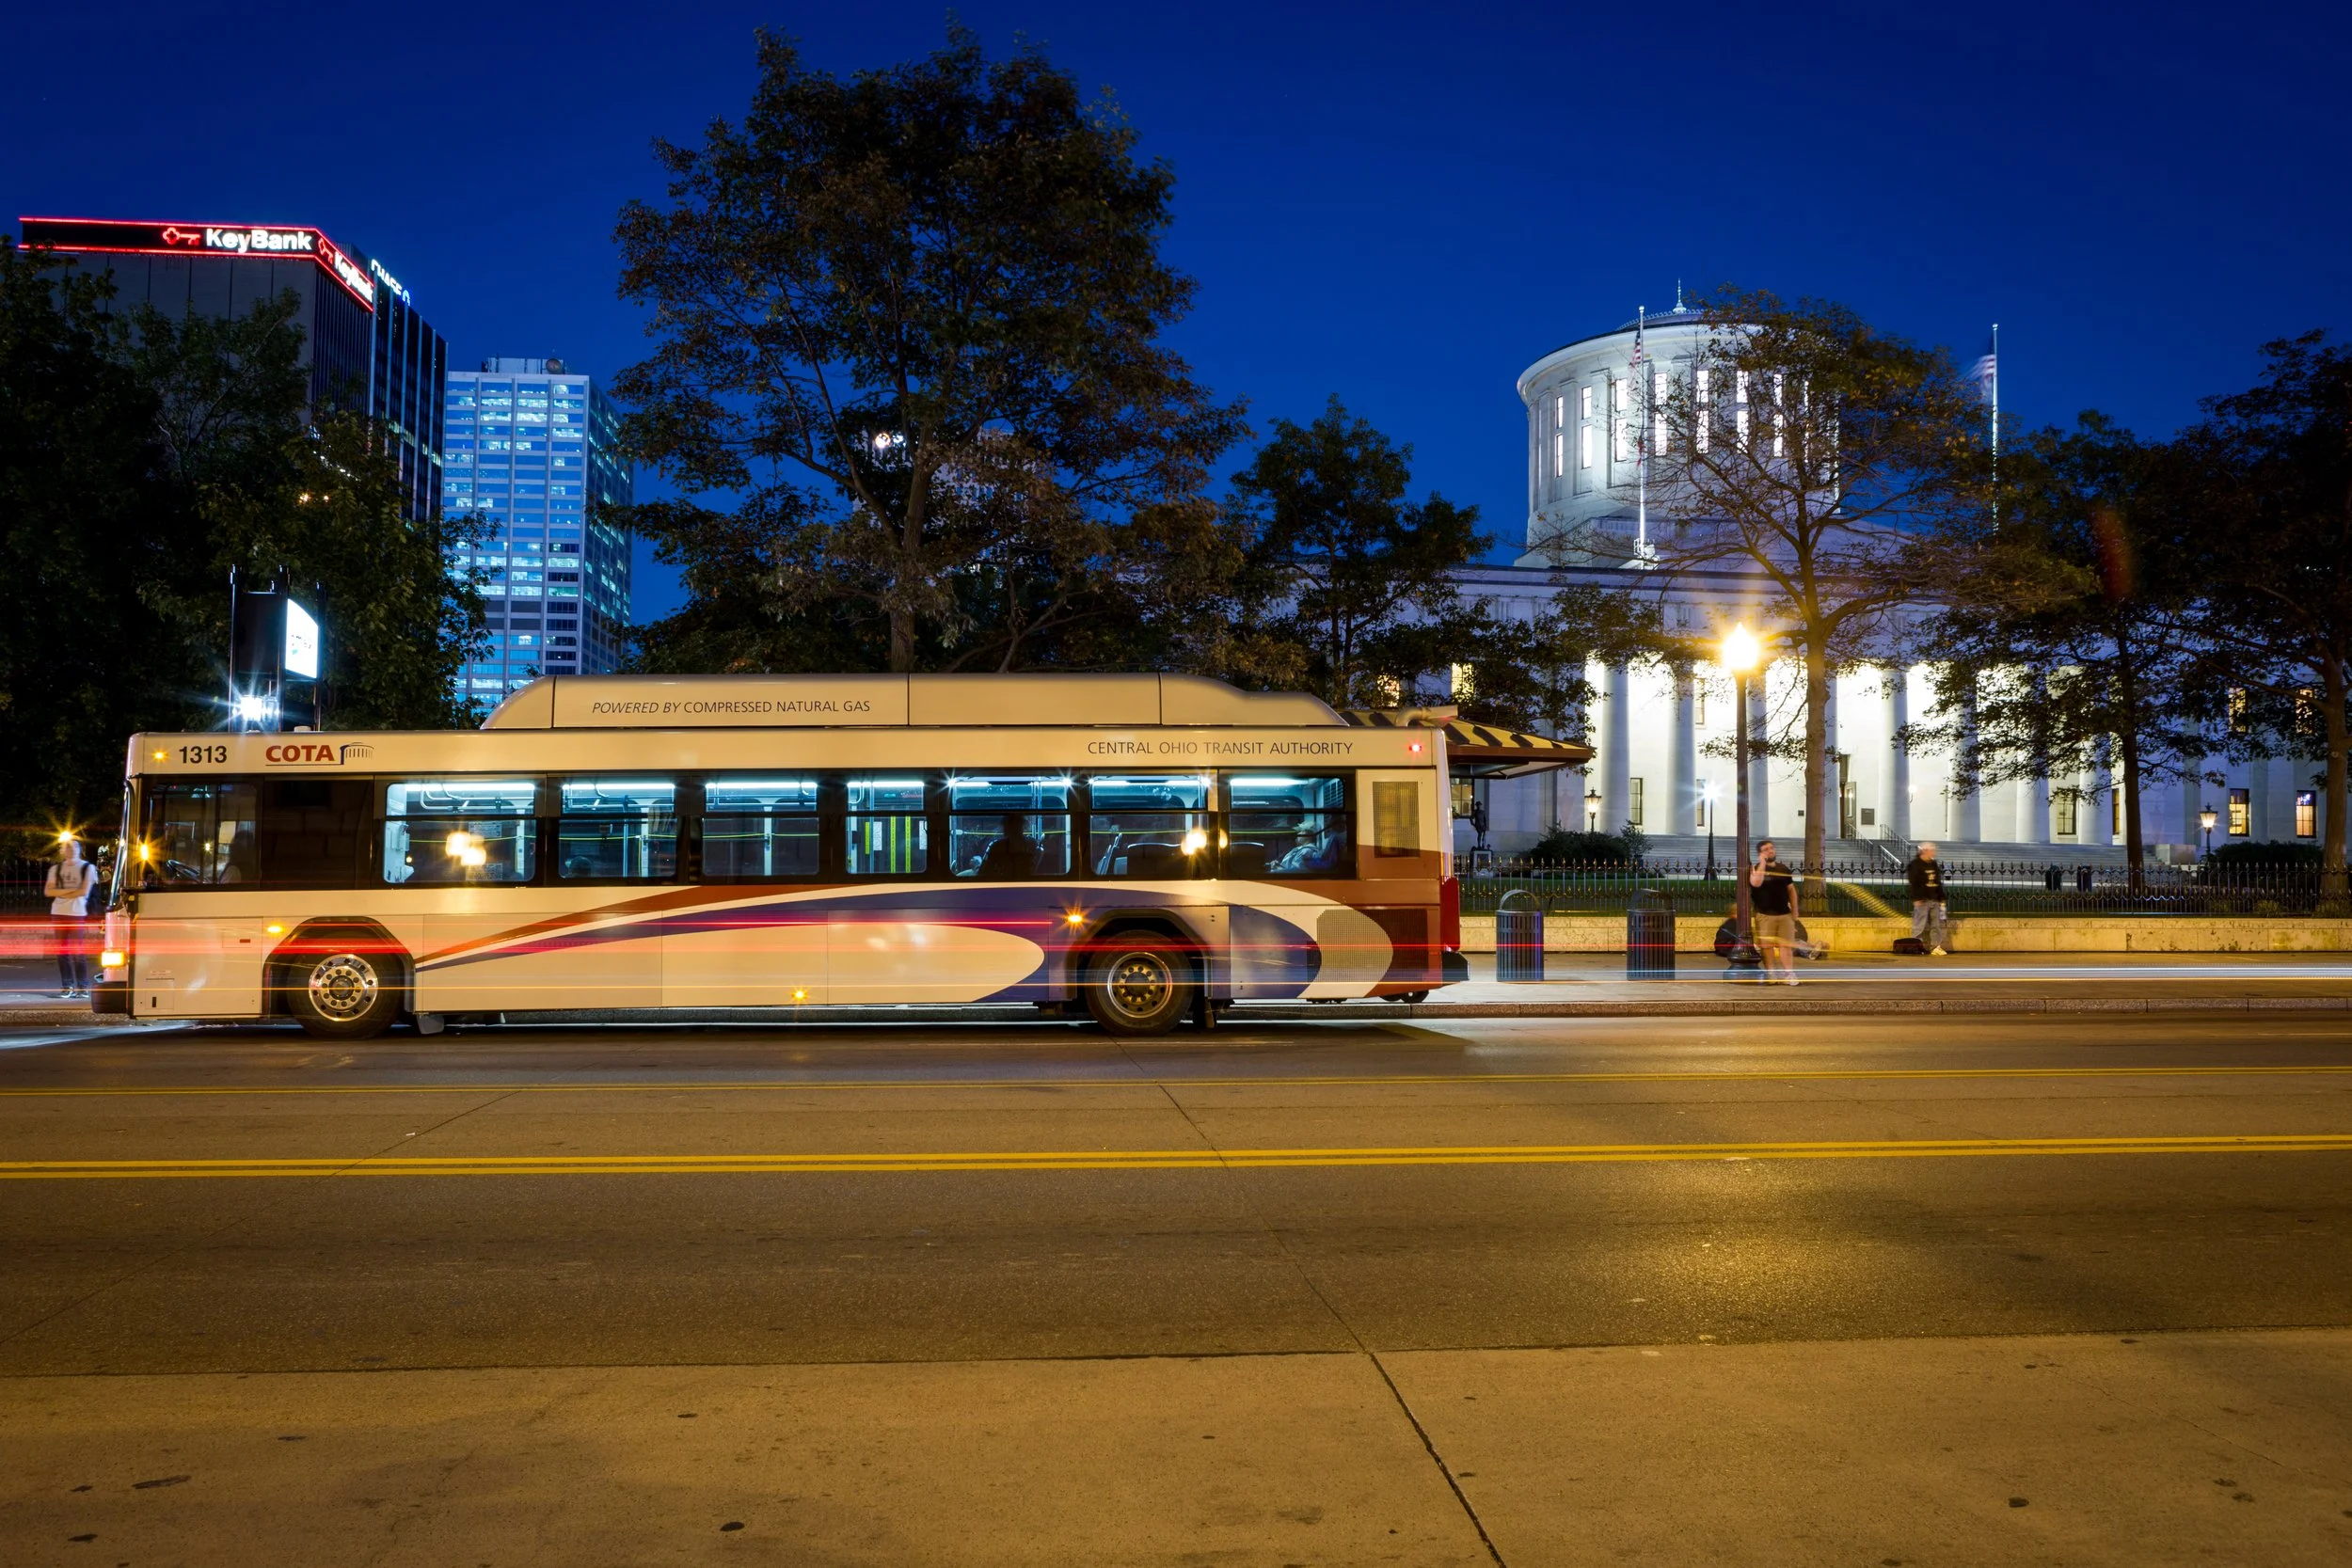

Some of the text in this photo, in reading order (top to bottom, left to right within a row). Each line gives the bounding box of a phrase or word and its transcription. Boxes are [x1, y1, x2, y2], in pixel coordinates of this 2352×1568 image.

[206, 228, 312, 253] KeyBank
[334, 250, 373, 303] KeyBank
[592, 700, 870, 714] POWERED BY COMPRESSED NATURAL GAS
[179, 745, 228, 764] 1313
[265, 744, 335, 763] COTA
[1087, 741, 1354, 754] CENTRAL OHIO TRANSIT AUTHORITY
